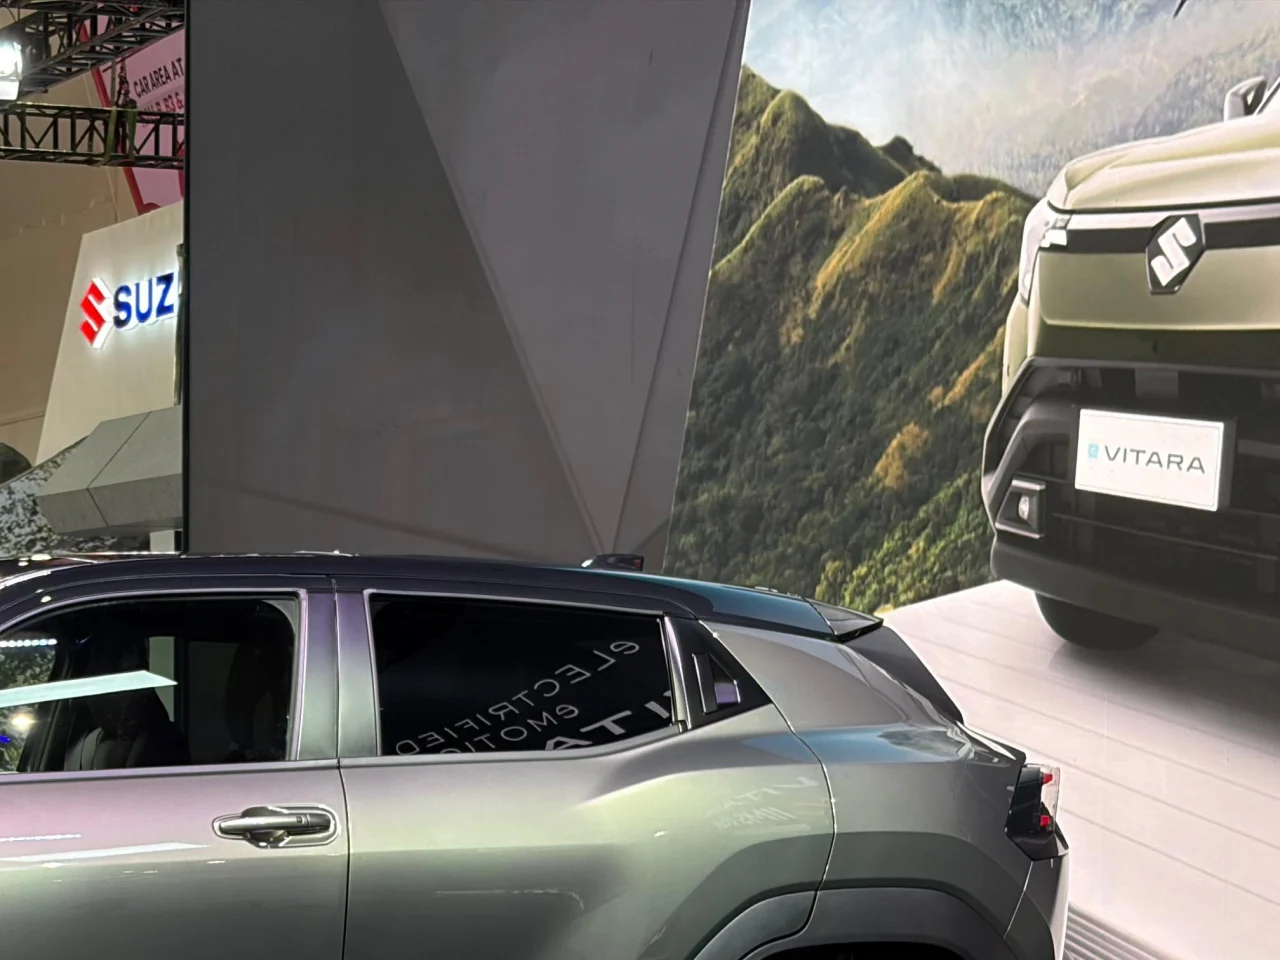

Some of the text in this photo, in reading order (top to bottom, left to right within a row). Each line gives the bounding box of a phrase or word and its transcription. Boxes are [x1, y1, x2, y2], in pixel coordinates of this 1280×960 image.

[134, 57, 184, 98] CAR AREA AT
[113, 272, 180, 329] SUZ
[1104, 445, 1206, 475] VITARA
